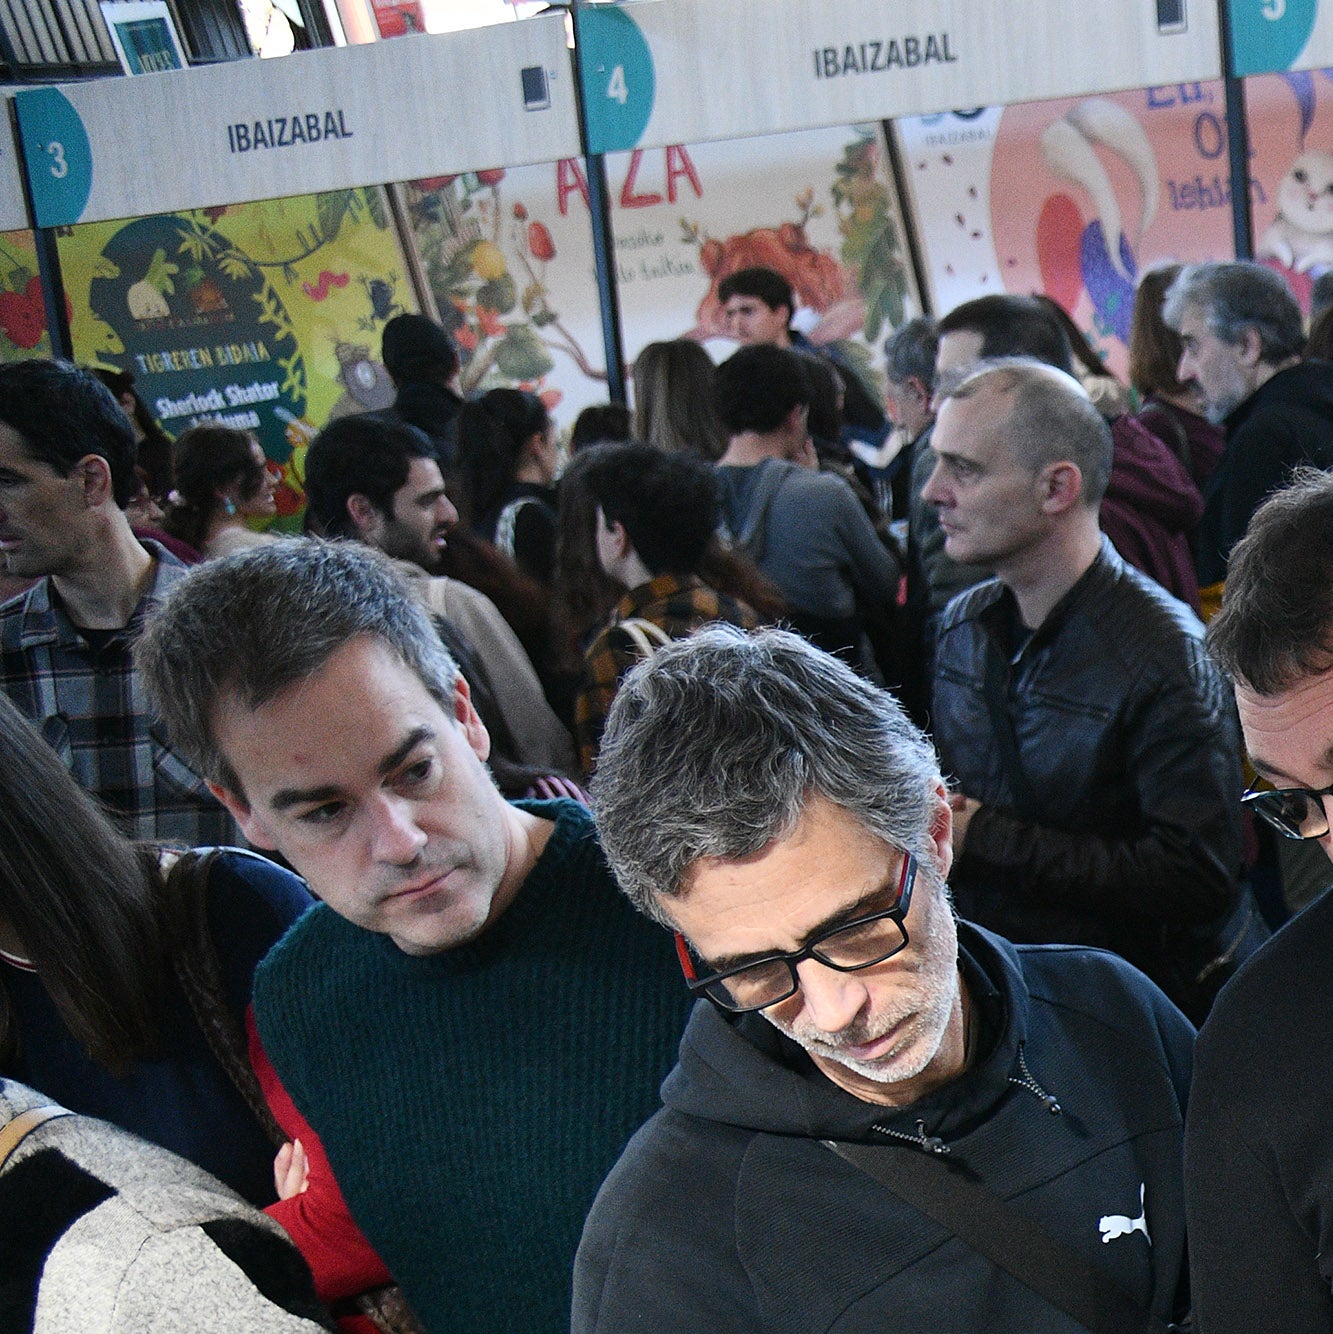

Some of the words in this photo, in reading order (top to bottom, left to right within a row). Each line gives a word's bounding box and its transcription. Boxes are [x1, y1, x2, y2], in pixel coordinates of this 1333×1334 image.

[813, 32, 957, 80] IBAIZABAL
[606, 66, 629, 104] 4
[227, 109, 353, 153] IBAIZABAL
[49, 141, 69, 180] 3
